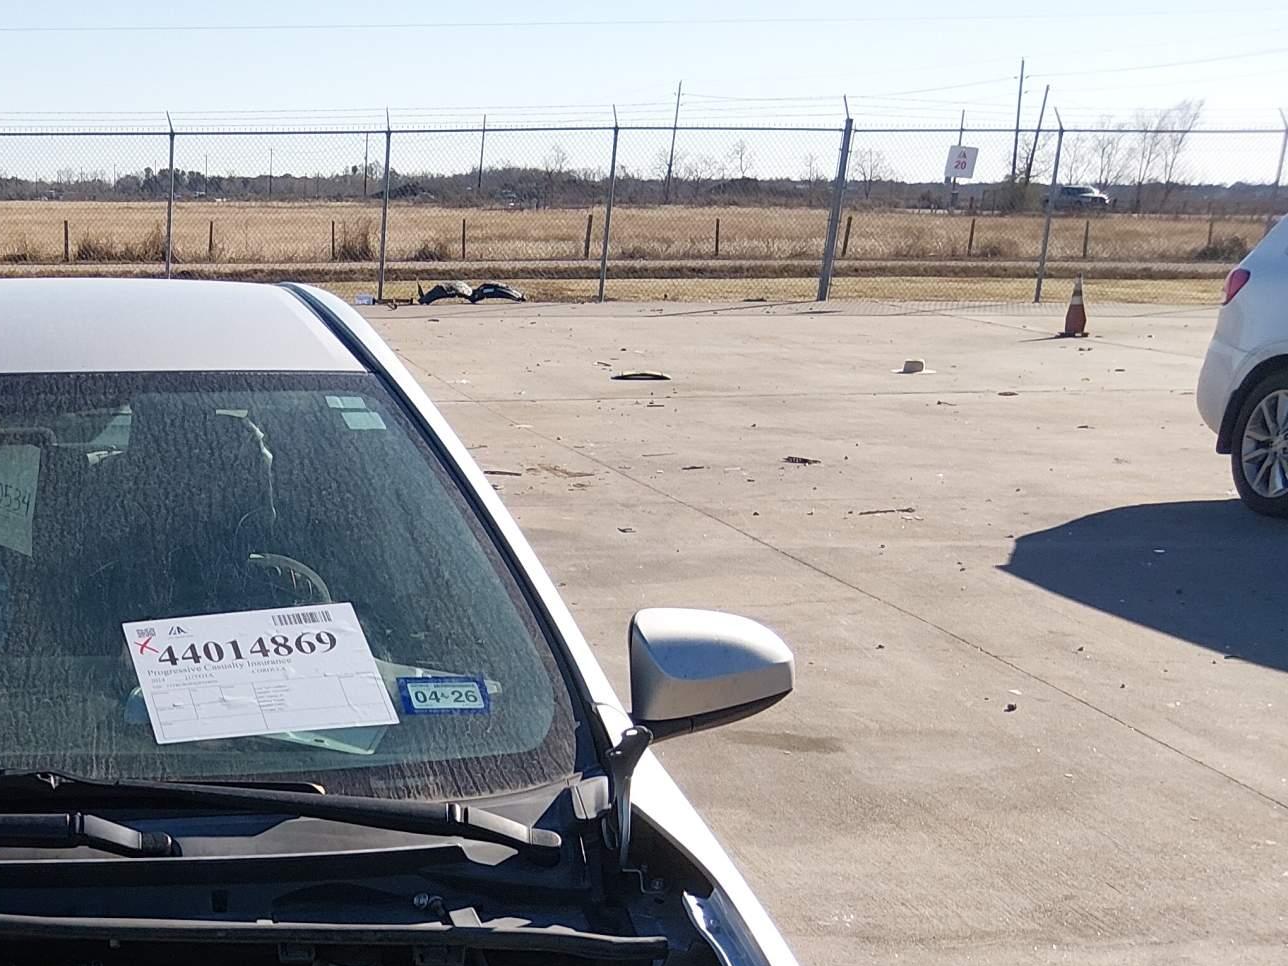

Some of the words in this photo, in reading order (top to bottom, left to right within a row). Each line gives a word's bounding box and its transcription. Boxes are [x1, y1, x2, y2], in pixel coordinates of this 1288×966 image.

[954, 160, 967, 170] 20
[158, 631, 337, 666] 44014869
[147, 663, 202, 678] Progressive
[204, 660, 245, 672] Casualty
[247, 657, 292, 668] Insurance
[415, 691, 440, 704] 04
[451, 690, 478, 703] 26
